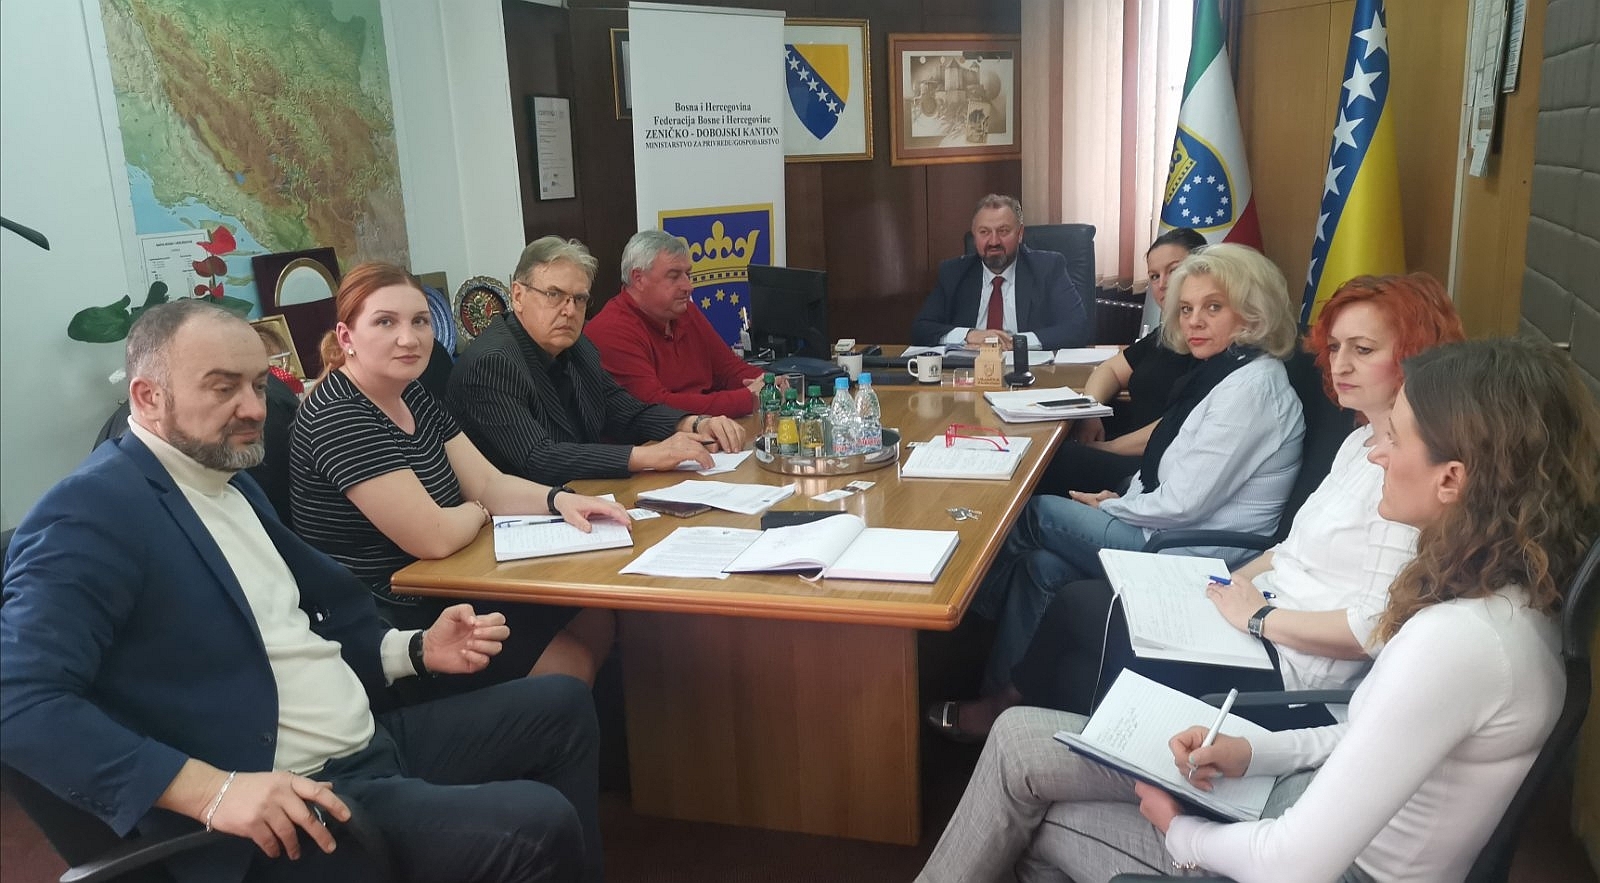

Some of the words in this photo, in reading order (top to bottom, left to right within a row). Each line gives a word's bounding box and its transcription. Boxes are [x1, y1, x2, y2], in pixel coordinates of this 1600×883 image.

[675, 102, 698, 112] Bosna
[705, 102, 751, 113] Hercegovina
[654, 116, 695, 127] Federacija
[698, 116, 720, 125] Bosne
[727, 115, 771, 125] Hercegovine
[645, 127, 689, 139] ZENIČKO
[696, 127, 741, 138] DOBOJSKI
[743, 127, 779, 137] KANTON
[645, 141, 692, 149] MINISTARSTVO
[693, 140, 702, 148] ZA
